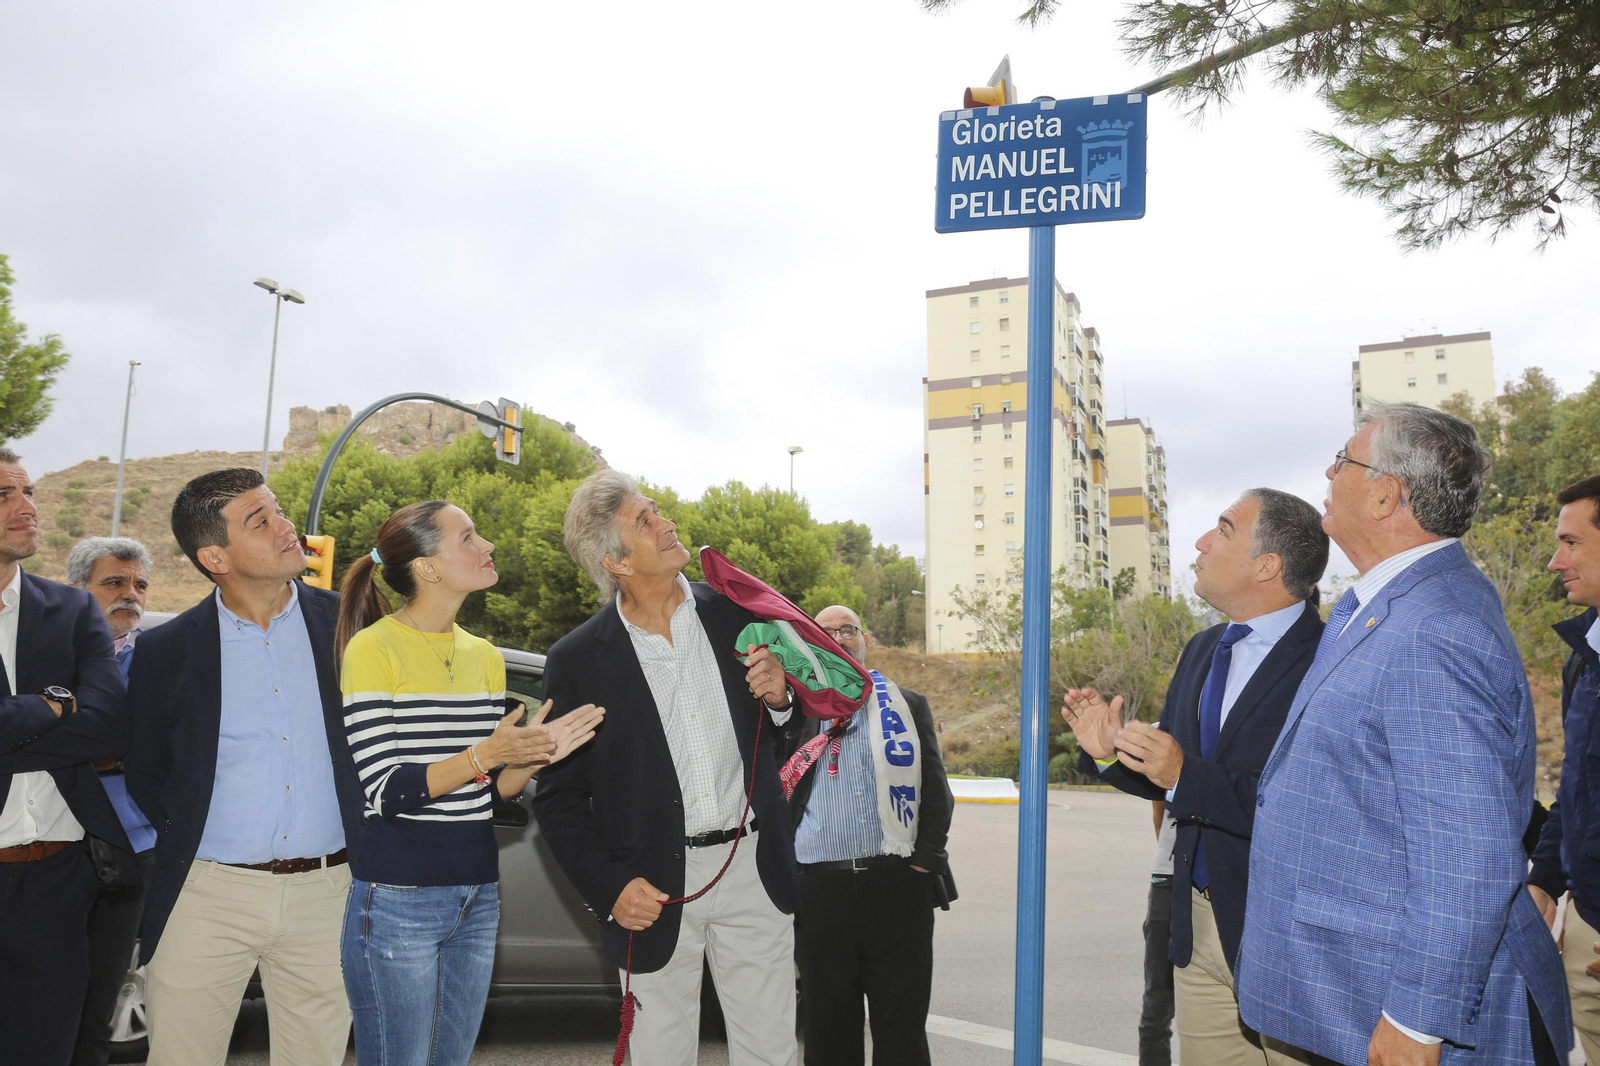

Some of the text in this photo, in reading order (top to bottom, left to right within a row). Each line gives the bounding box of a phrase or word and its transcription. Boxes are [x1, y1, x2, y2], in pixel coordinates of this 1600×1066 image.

[952, 114, 1062, 145] Glorieta
[951, 147, 1075, 182] MANUEL
[950, 181, 1121, 219] PELLEGRINI
